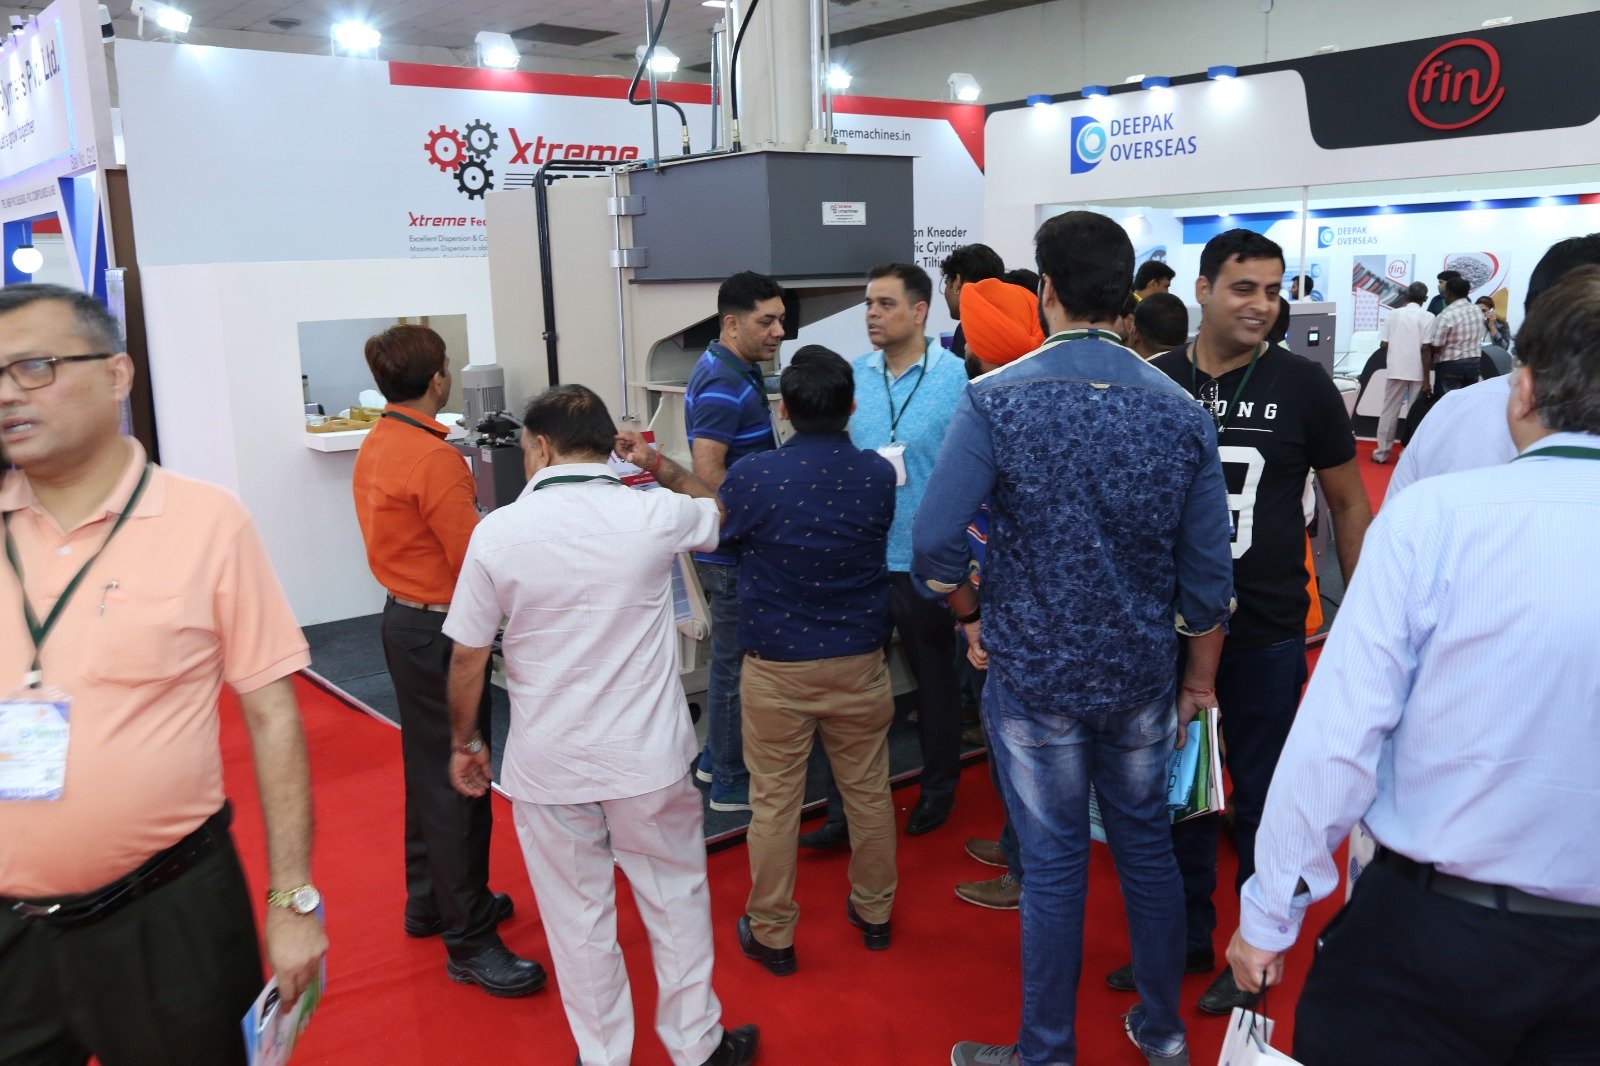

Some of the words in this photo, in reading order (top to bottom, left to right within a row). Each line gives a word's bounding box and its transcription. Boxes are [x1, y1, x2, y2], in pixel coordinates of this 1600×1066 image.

[41, 40, 60, 81] Ltd.
[1110, 112, 1174, 137] DEEPAK
[507, 127, 639, 165] Xtreme
[1110, 135, 1197, 161] OVERSEAS
[408, 211, 467, 227] Xtreme
[409, 235, 438, 243] Excellent
[438, 234, 471, 243] Dispersion
[927, 225, 967, 238] Kneader
[1337, 226, 1368, 236] DEEPAK
[1337, 235, 1378, 246] OVERSEAS
[440, 244, 470, 253] Dispersion
[926, 241, 967, 256] Cylinde
